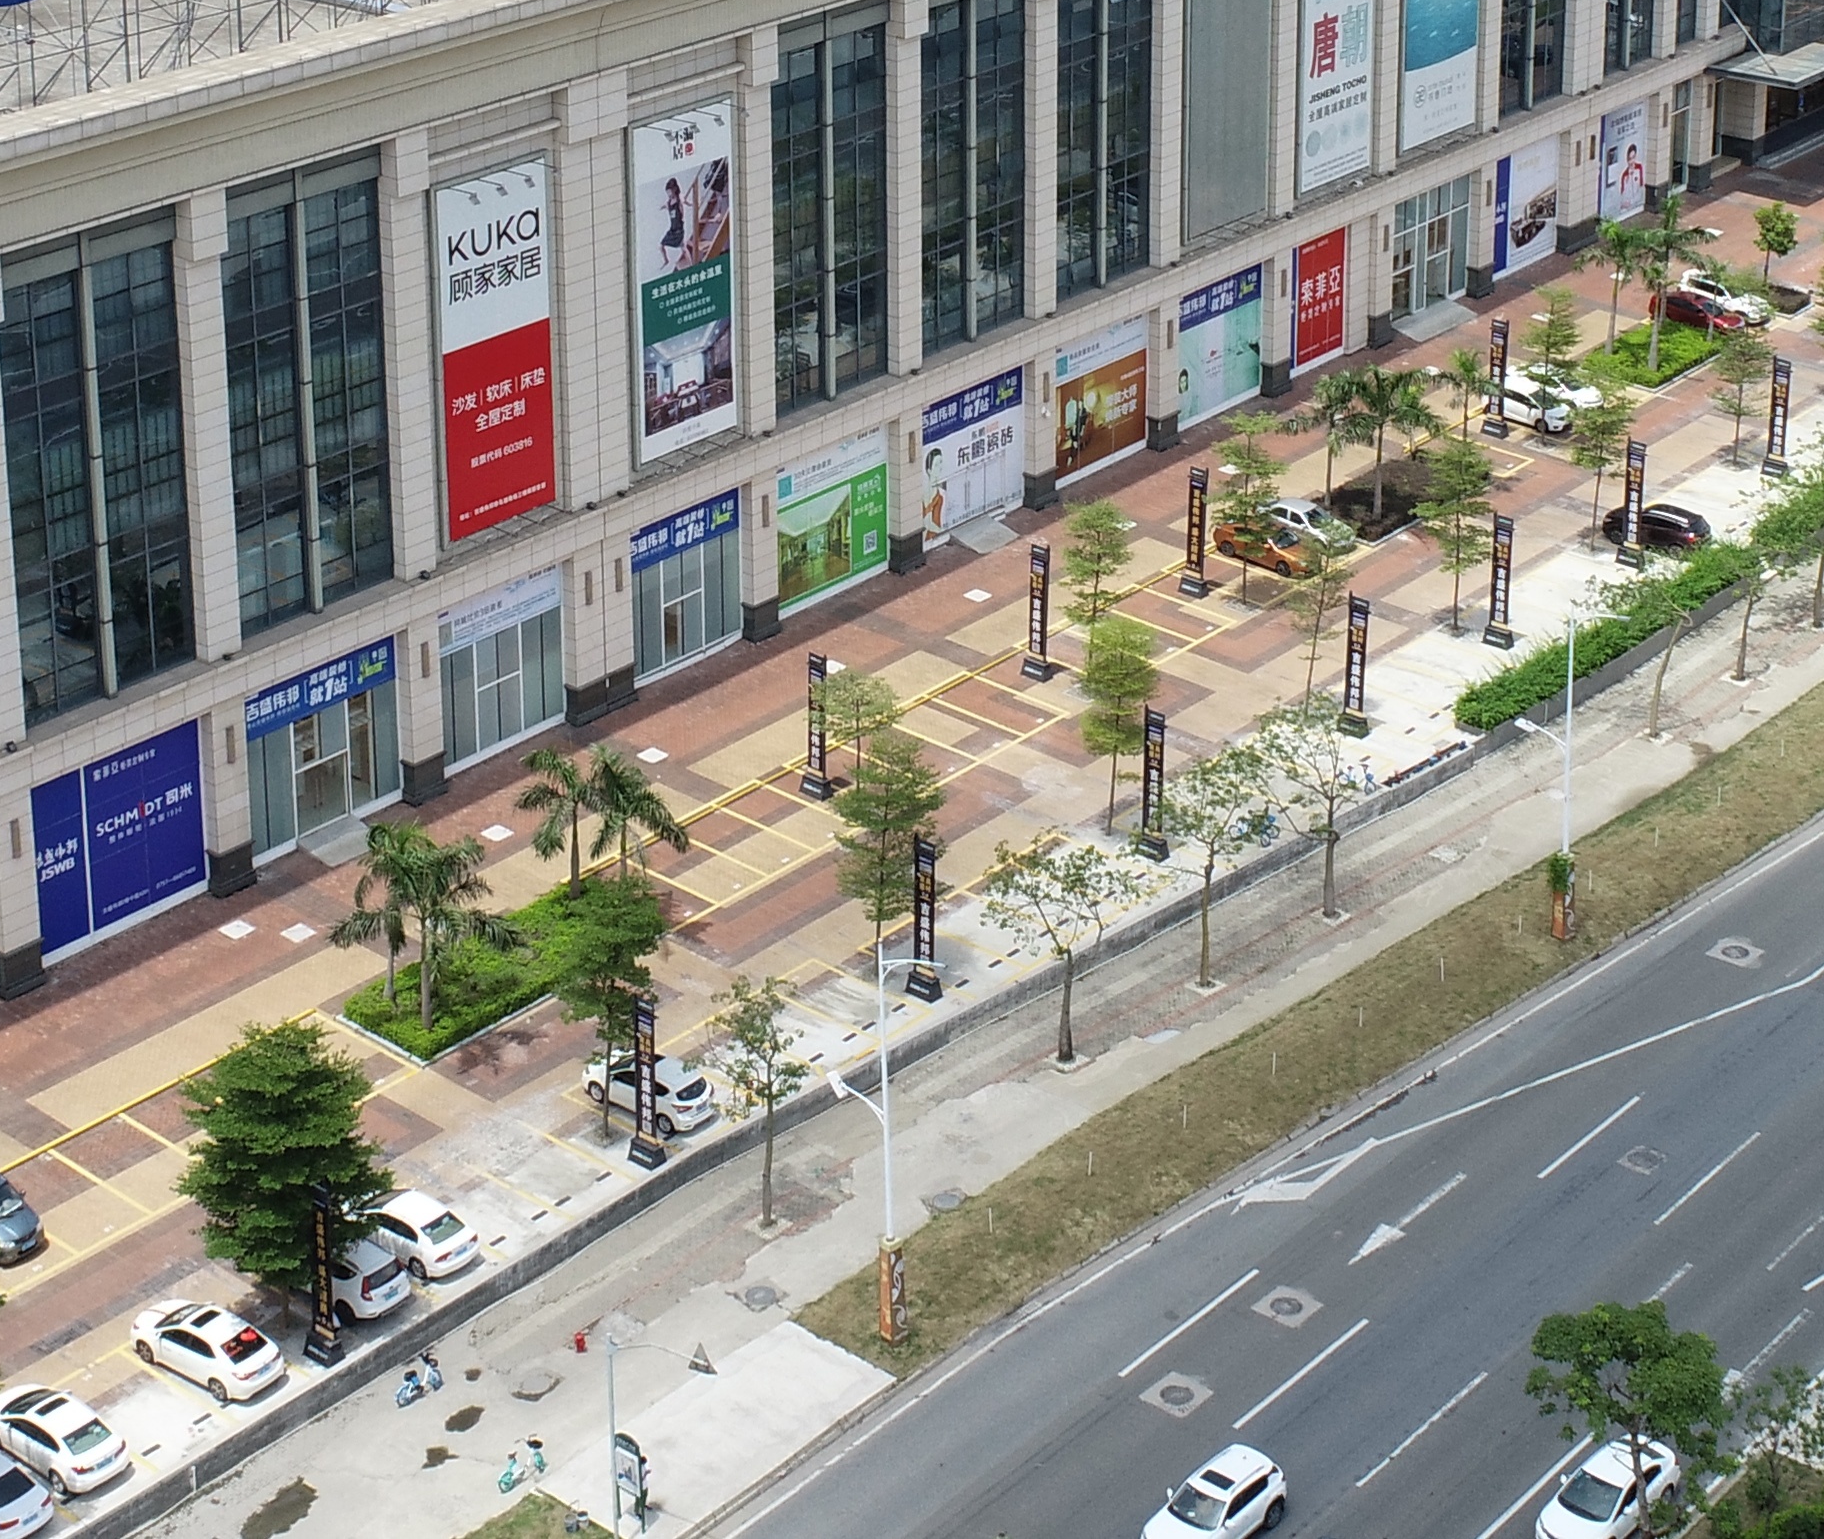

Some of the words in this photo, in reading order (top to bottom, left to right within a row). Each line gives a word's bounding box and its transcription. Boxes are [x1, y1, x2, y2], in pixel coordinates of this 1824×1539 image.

[1309, 1, 1369, 80] 唐朝
[449, 246, 542, 305] 顾家家居
[452, 392, 477, 416] 沙发
[486, 379, 513, 402] 软床
[521, 367, 546, 391] 床垫
[475, 398, 526, 432] 全屋定制
[957, 425, 1014, 467] 东鹏瓷砖
[308, 660, 347, 686] 高端装修
[309, 676, 348, 706] 就1站
[246, 684, 300, 723] 吉盛伟邦
[95, 796, 164, 838] SCHMIDT
[165, 781, 194, 807] 司米
[40, 857, 75, 883] JSWB
